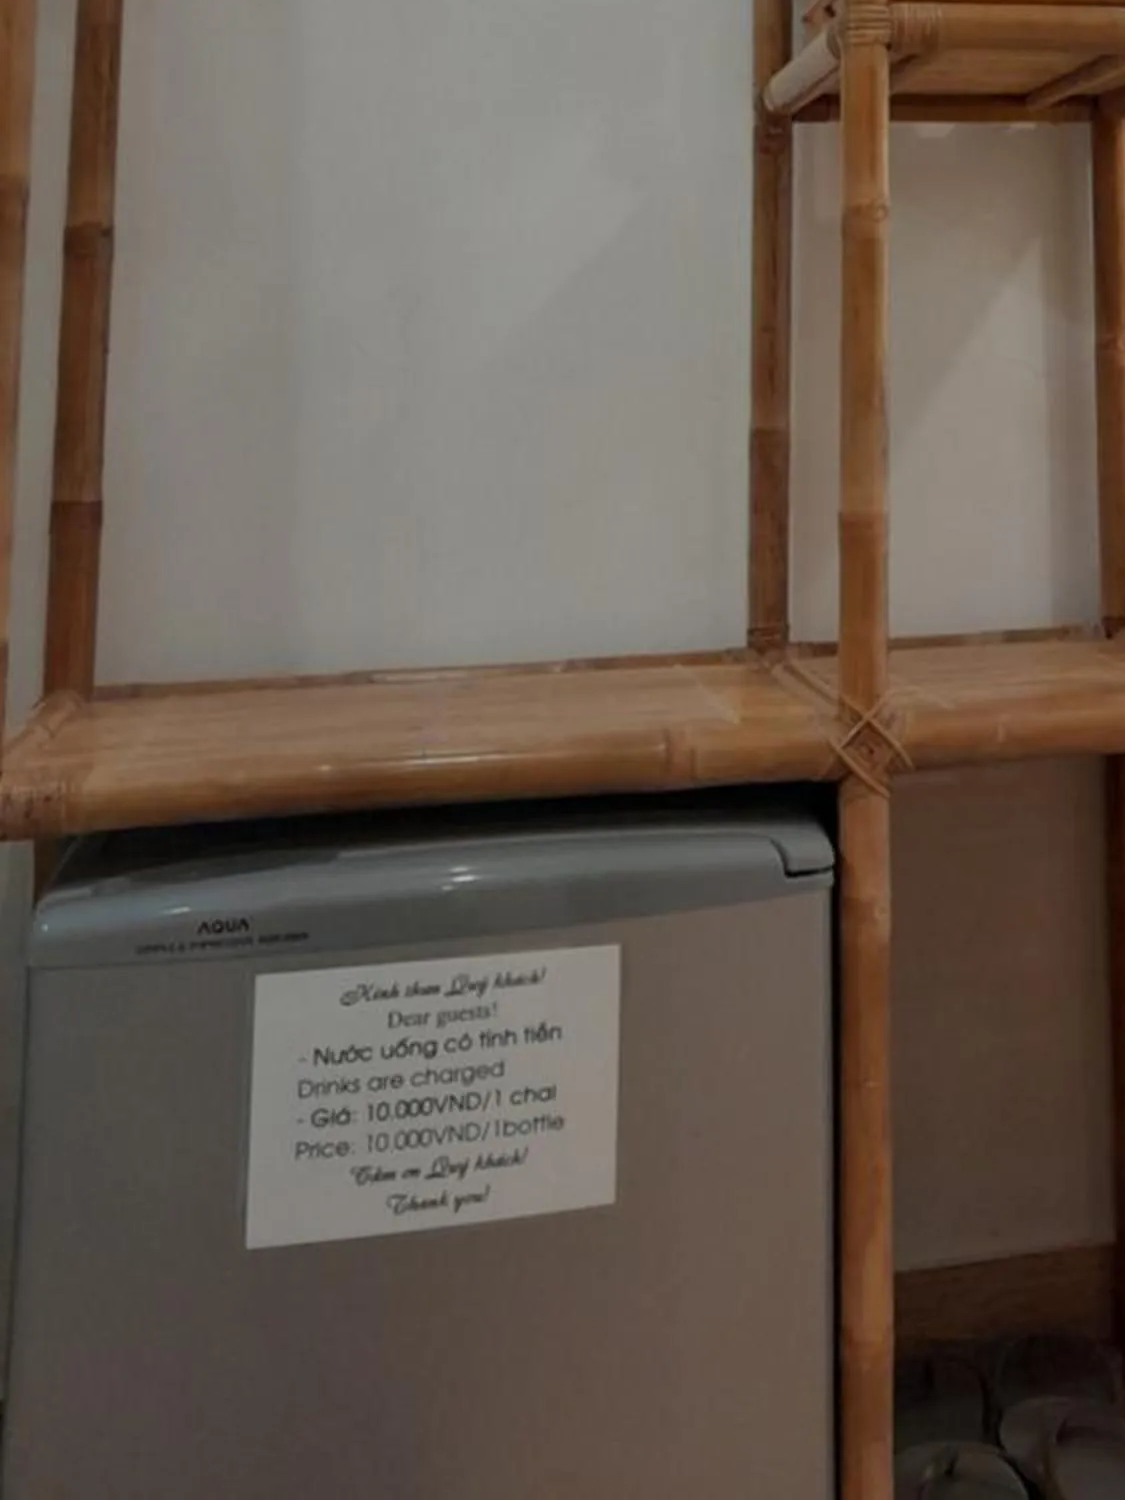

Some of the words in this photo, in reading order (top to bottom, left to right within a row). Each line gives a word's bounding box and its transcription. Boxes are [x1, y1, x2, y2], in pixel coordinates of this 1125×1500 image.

[197, 917, 250, 935] AQUA
[388, 1010, 430, 1029] Dear
[436, 1001, 498, 1029] guests!
[298, 1078, 361, 1100] Drinks
[366, 1074, 404, 1092] are
[410, 1060, 505, 1088] charged
[509, 1084, 557, 1106] chai
[295, 1140, 357, 1160] Price:
